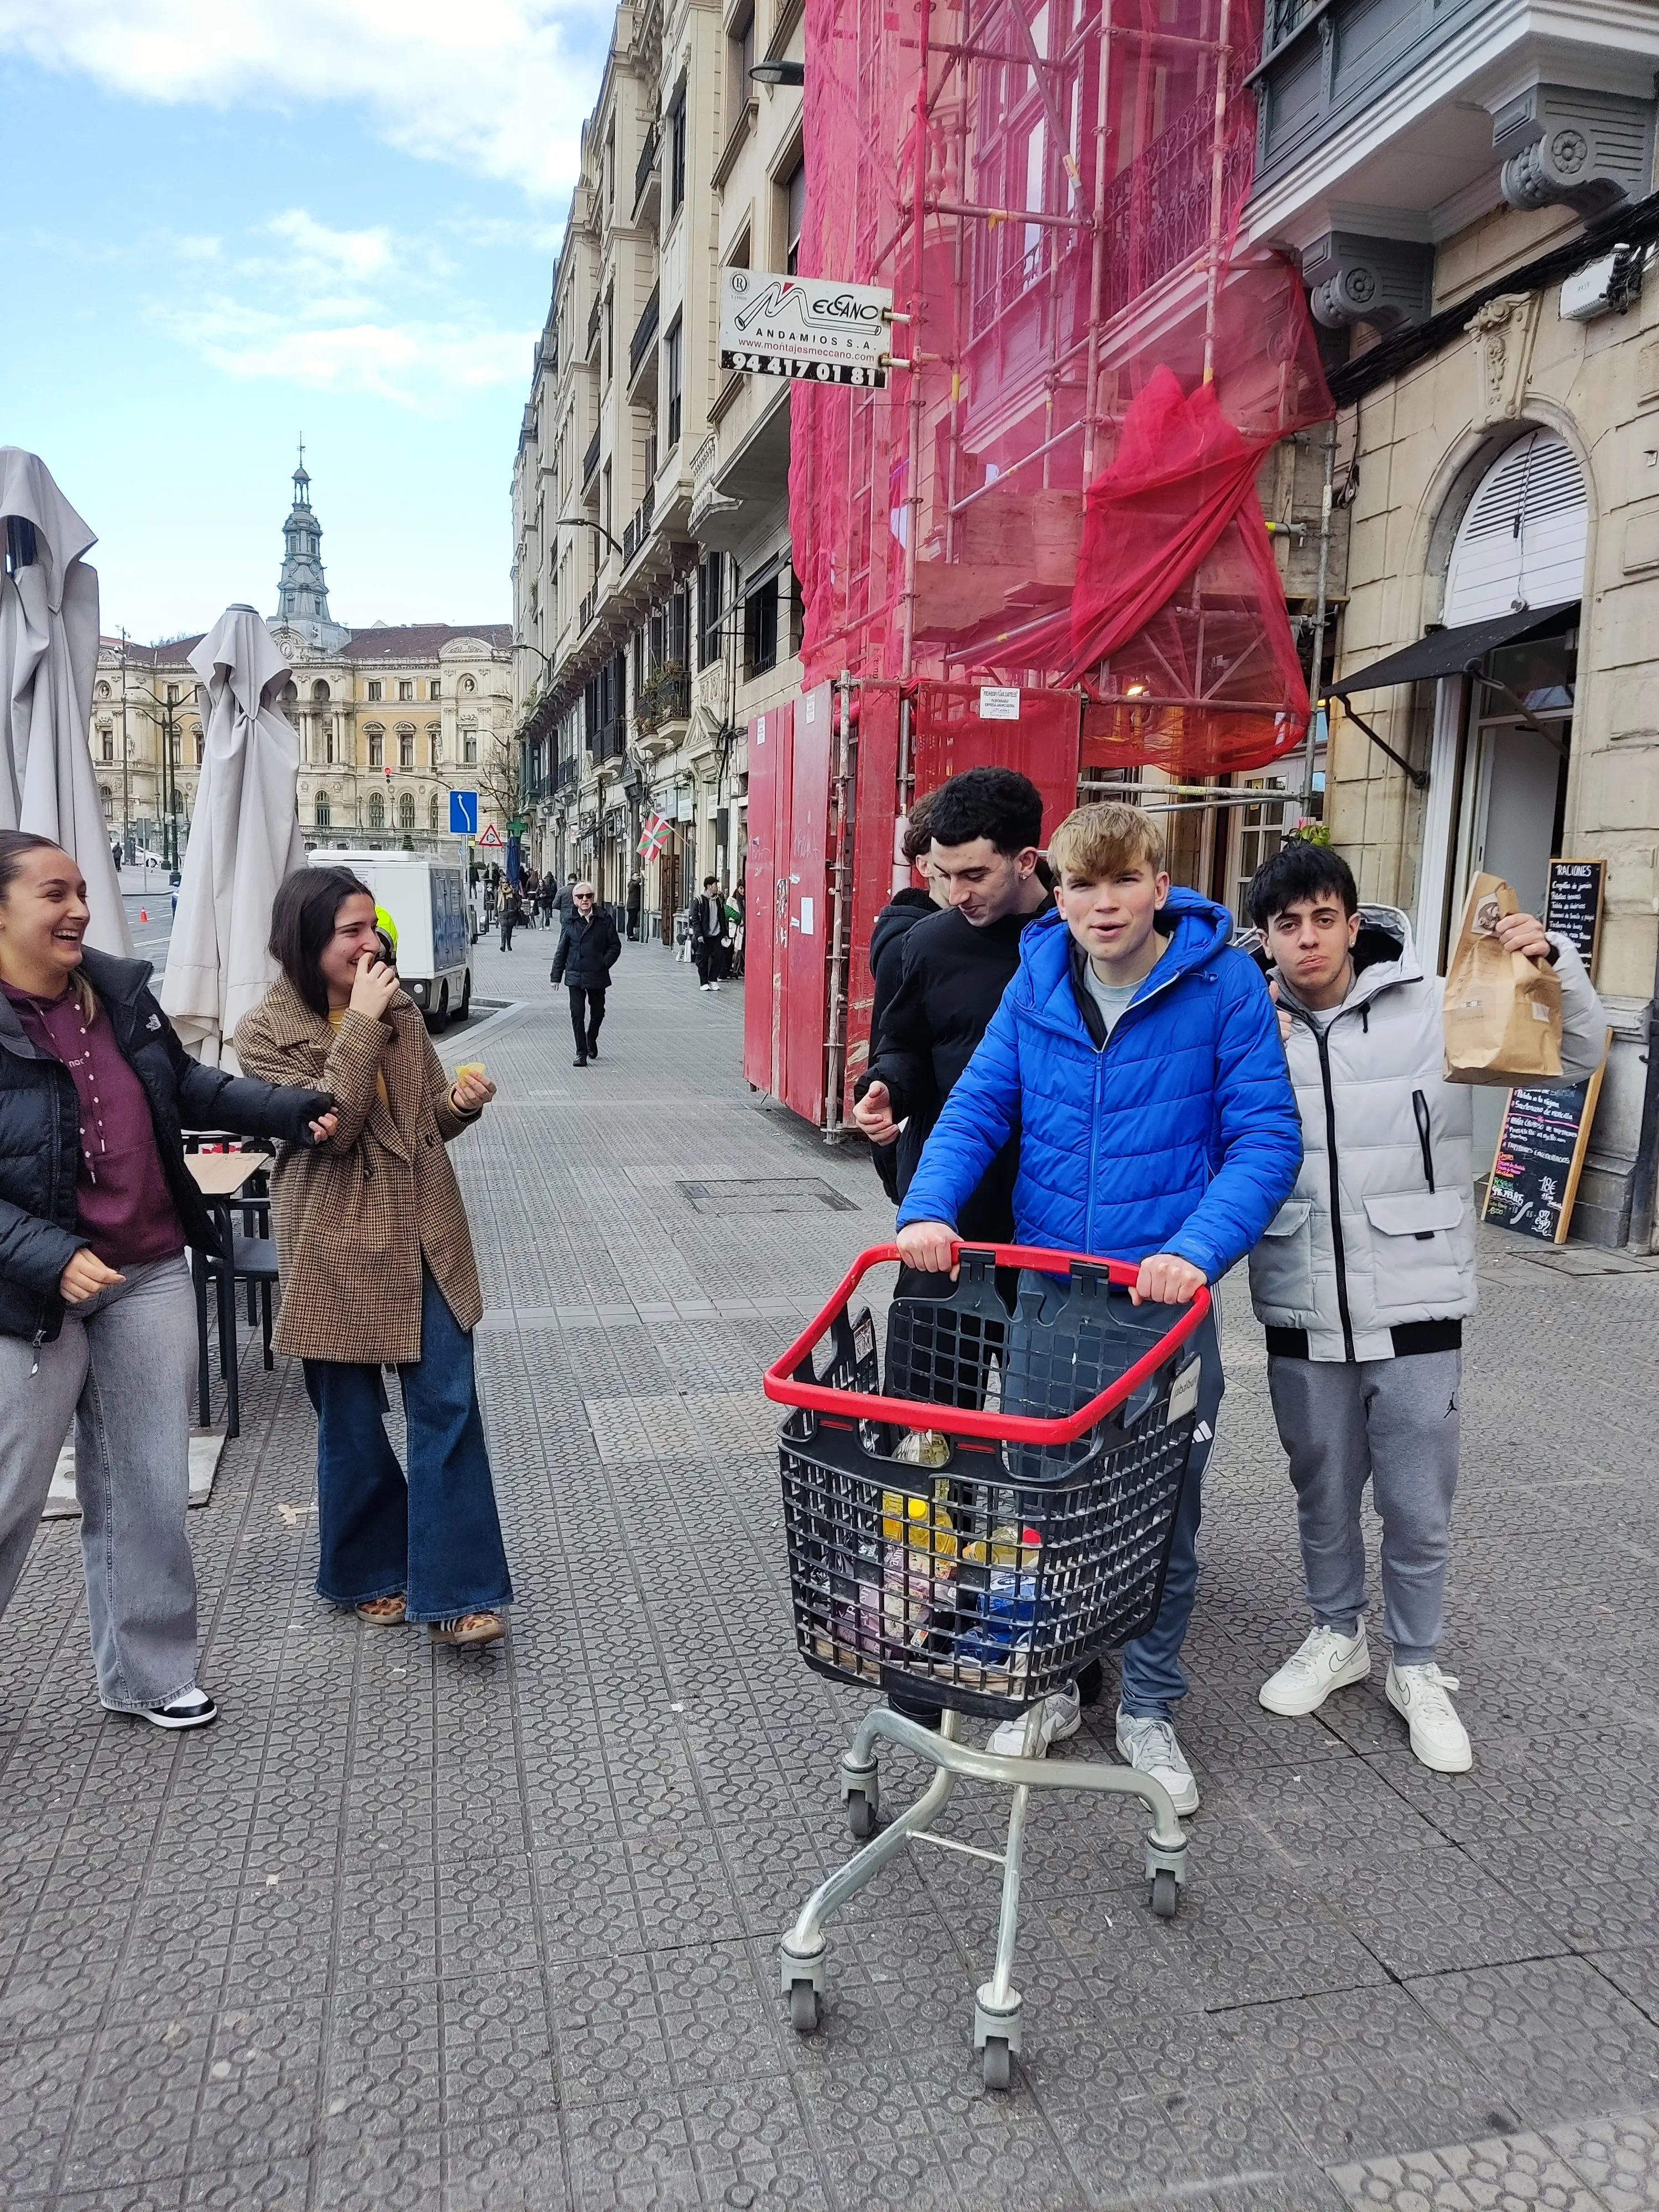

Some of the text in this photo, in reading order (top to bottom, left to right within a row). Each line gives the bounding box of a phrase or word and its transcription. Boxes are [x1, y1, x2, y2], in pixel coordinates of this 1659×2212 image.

[755, 327, 838, 346] ANDAMIOS
[738, 338, 875, 362] www.montajesmeccano.com
[732, 352, 877, 387] 94 417 01 81
[1555, 864, 1592, 877] RACIONES
